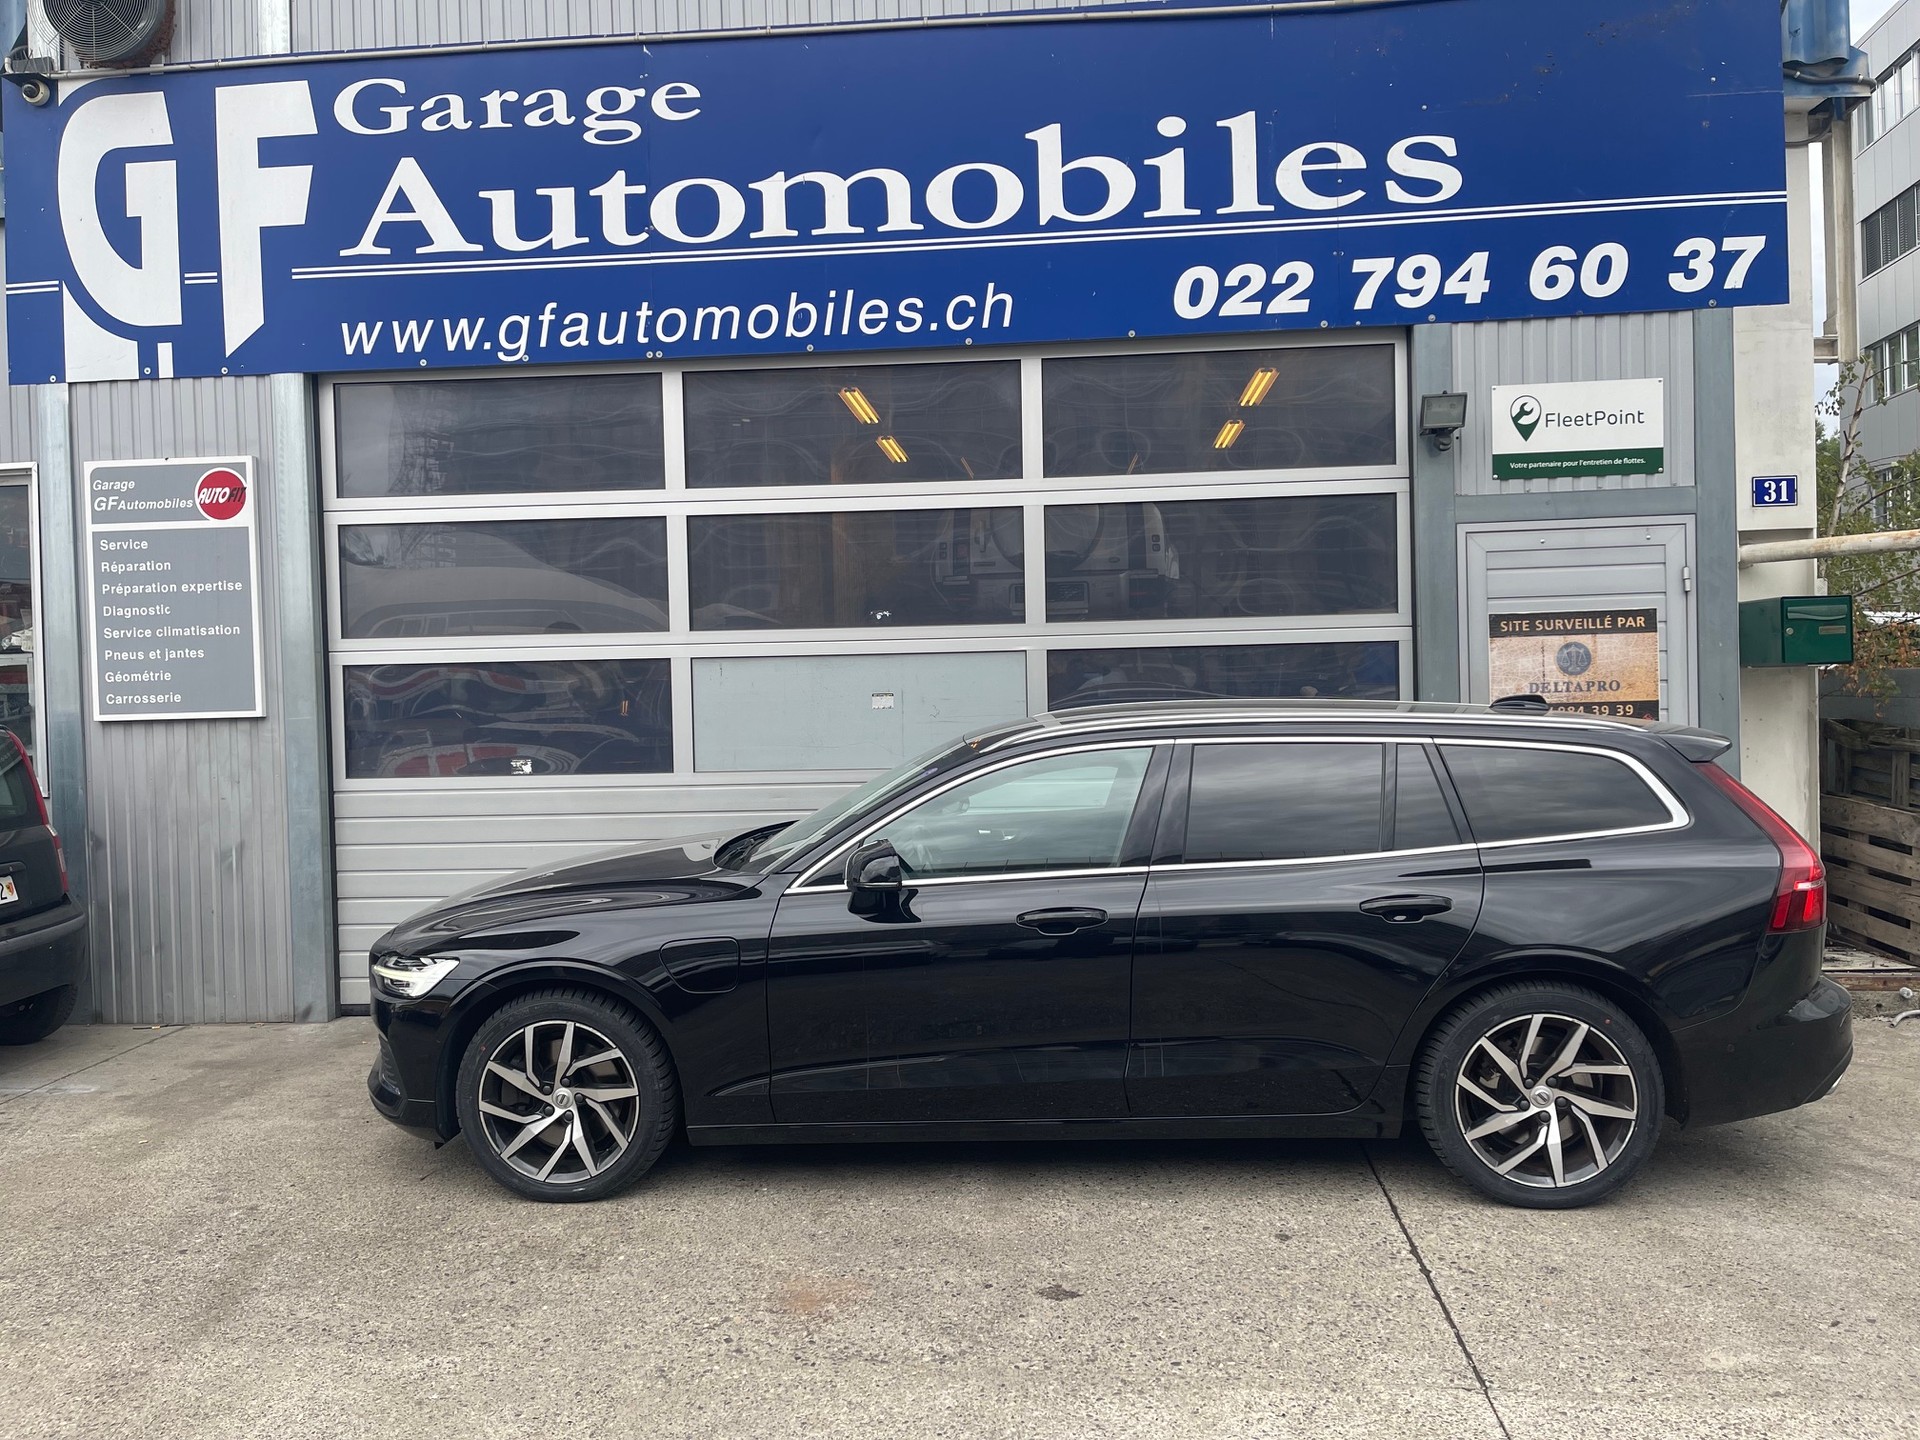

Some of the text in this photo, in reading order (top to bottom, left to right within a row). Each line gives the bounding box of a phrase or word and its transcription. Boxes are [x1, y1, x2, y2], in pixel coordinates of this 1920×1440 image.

[333, 78, 701, 145] Garage
[339, 111, 1463, 257] Automobiles
[57, 79, 319, 358] GF
[1173, 235, 1767, 320] 022 794 60 37
[341, 283, 1013, 362] www.gfautomobiles.ch
[1545, 409, 1645, 428] FleetPoint
[1528, 460, 1562, 470] partenaire
[92, 479, 136, 492] Garage
[1763, 480, 1789, 503] 31
[198, 486, 248, 505] AUTOFIT
[99, 538, 149, 551] Service
[101, 560, 172, 575] Réparation
[102, 580, 243, 597] Préparation expertise
[102, 604, 171, 619] Diagnostic
[1500, 615, 1646, 632] SITE SURVEILLÉ PAR
[103, 625, 241, 639] Service climatisation
[104, 648, 205, 662] Pneus et jantes
[104, 670, 172, 683] Géométrie
[1529, 680, 1621, 694] DELTAPRO
[105, 692, 182, 705] Carrosserie
[1592, 705, 1610, 716] 39
[1616, 704, 1634, 716] 39
